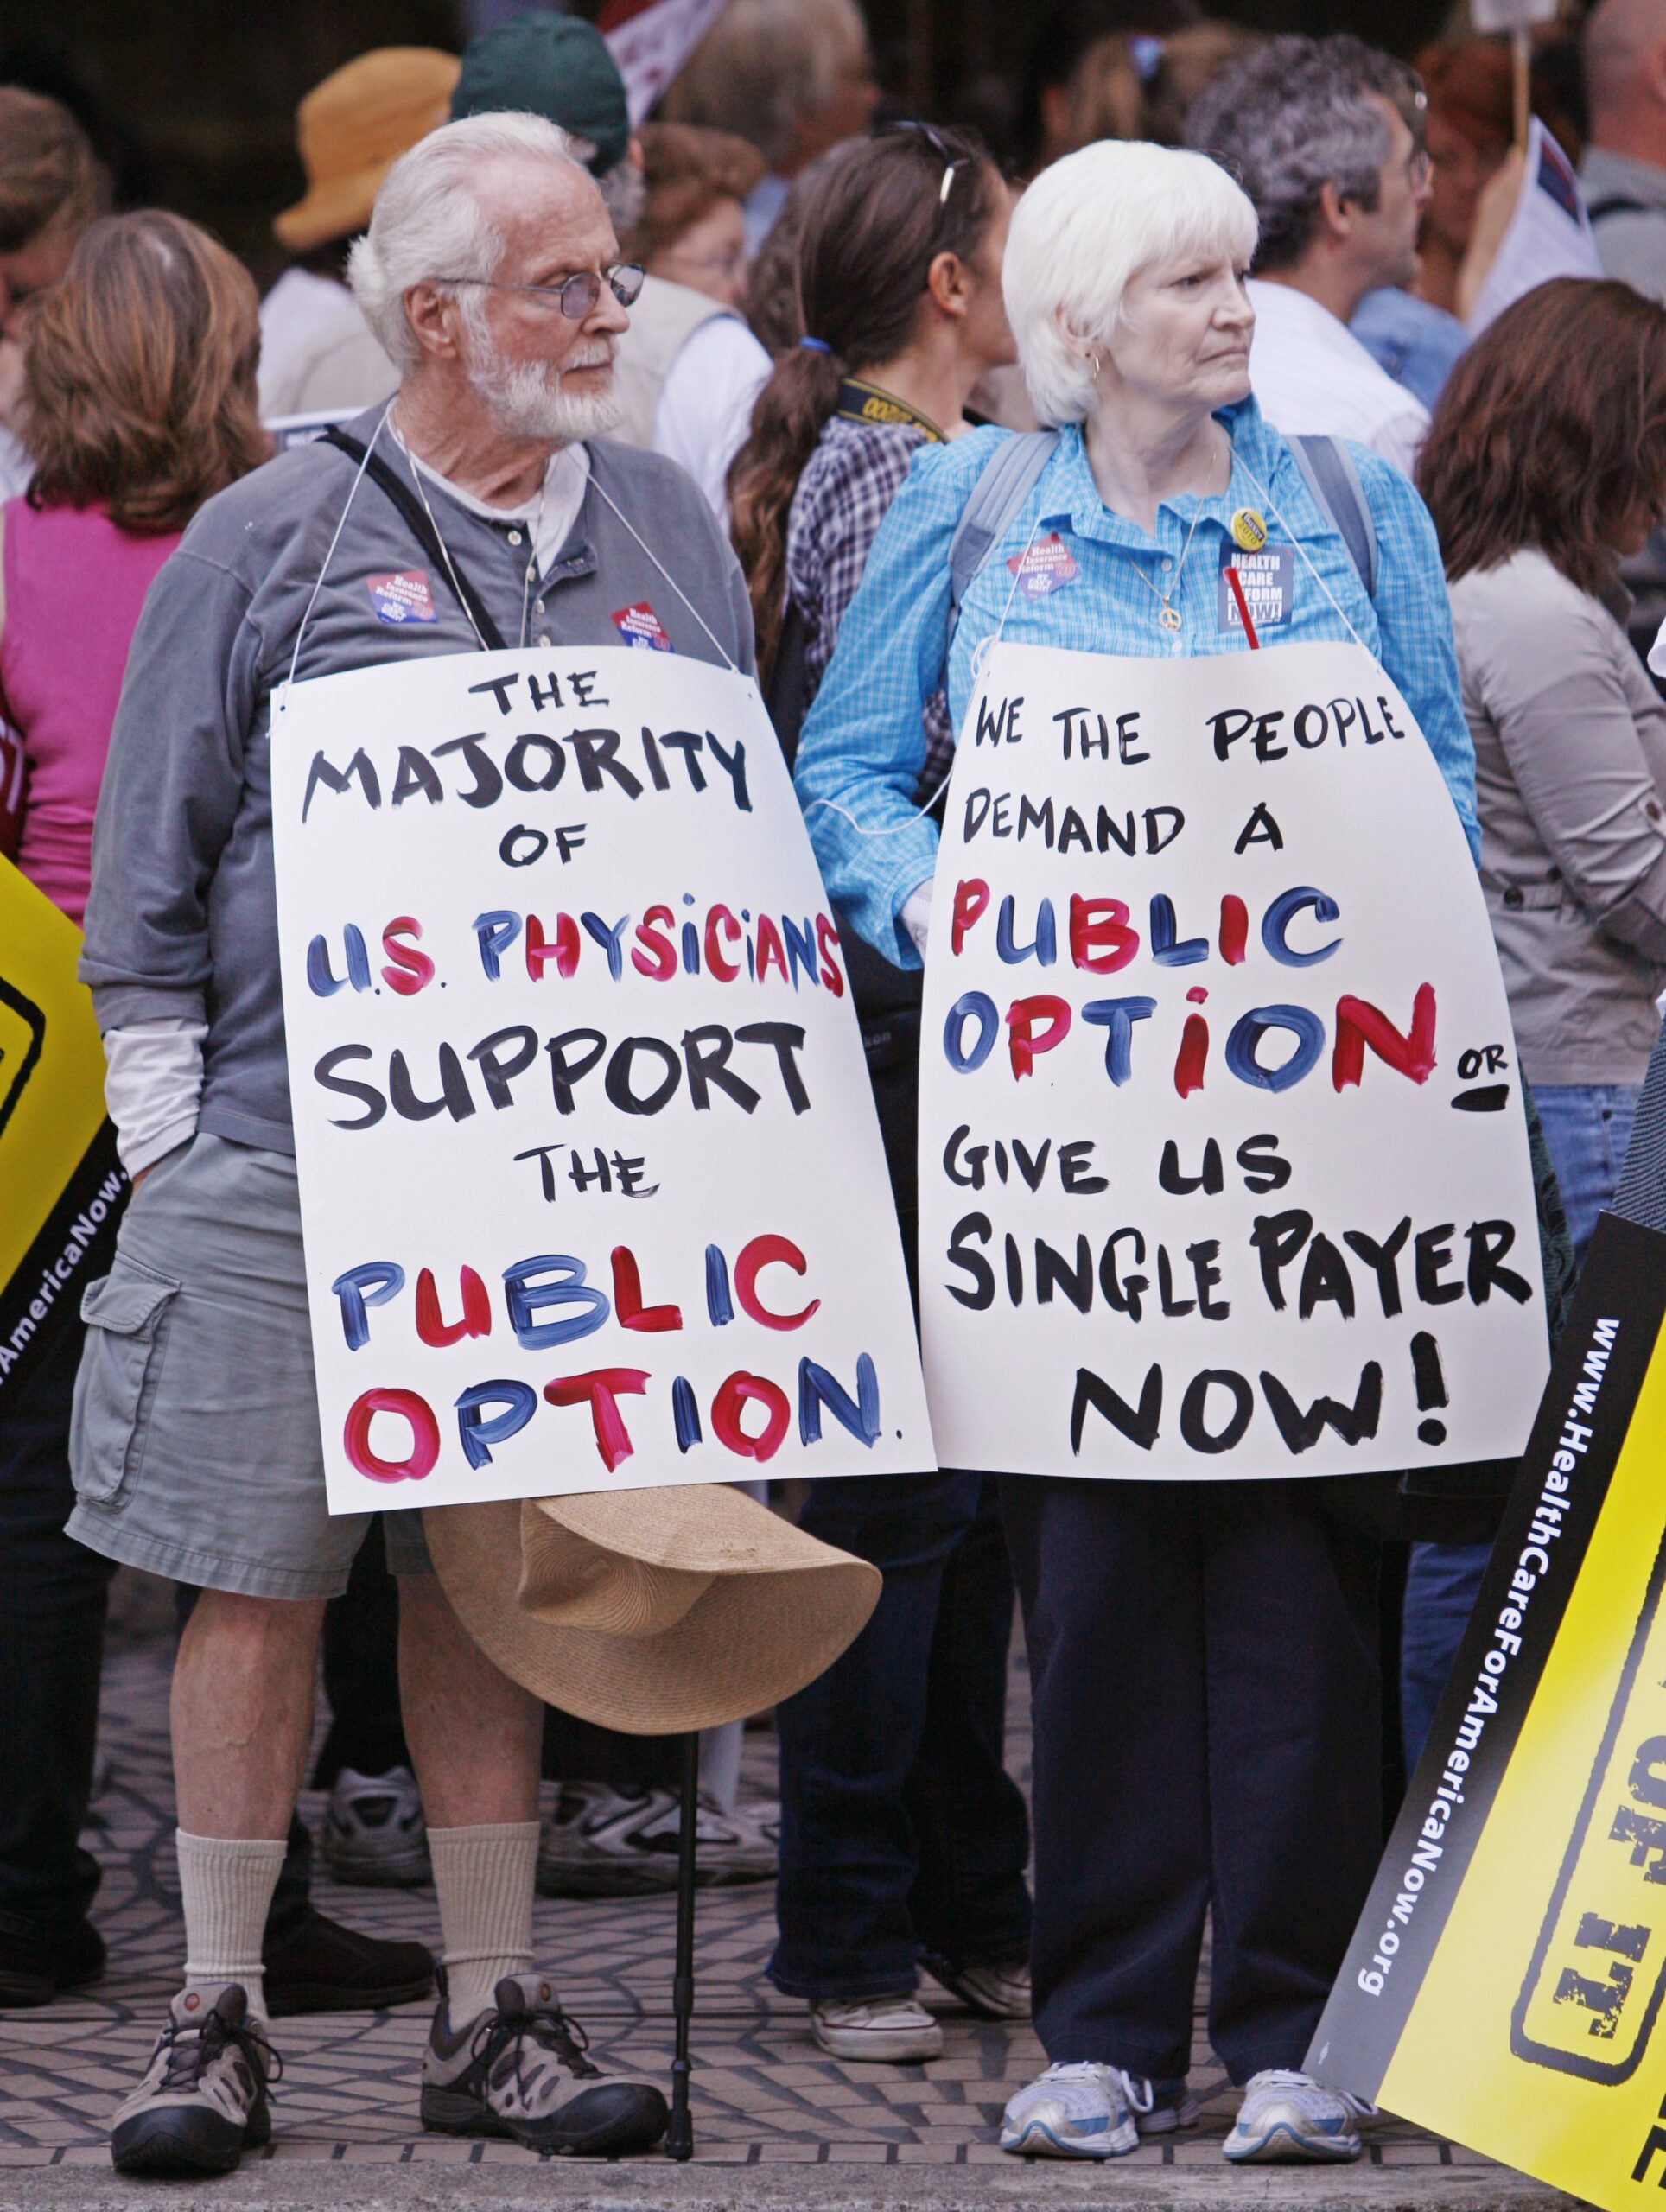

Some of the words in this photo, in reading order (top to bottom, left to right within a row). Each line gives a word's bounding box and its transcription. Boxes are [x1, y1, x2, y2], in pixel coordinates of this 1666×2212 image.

[1026, 553, 1068, 565] Insurance
[1032, 543, 1065, 556] Health
[1231, 553, 1281, 570] HEALTH
[1238, 522, 1257, 544] 2010
[375, 585, 413, 607] Reform
[385, 581, 429, 604] Insurance
[394, 575, 428, 595] Health
[1228, 588, 1282, 601] RFORM
[1239, 571, 1274, 586] CARE
[629, 607, 658, 625] Health
[468, 671, 609, 715] THE
[976, 696, 1025, 747] WE
[1052, 707, 1151, 765] THE
[1205, 696, 1406, 764] PEOPLE
[302, 727, 753, 823] MAJORITY
[499, 824, 587, 868] OF
[963, 787, 1186, 856] DEMAND
[1234, 802, 1284, 855] A
[307, 916, 447, 997] U.S.
[951, 878, 1345, 975] PUBLIC
[314, 1021, 811, 1130] SUPPORT
[1457, 1044, 1509, 1080] OR
[513, 1143, 661, 1202] THE
[943, 1124, 1110, 1195] GIVE
[1159, 1134, 1292, 1195] US
[0, 1171, 128, 1387] AmericaNow.
[332, 1234, 821, 1351] PUBLIC
[943, 1211, 1230, 1323] SINGLE
[1250, 1209, 1533, 1320] PAYER
[343, 1351, 904, 1484] OPTION.
[1071, 1331, 1450, 1457] NOW!
[1357, 1319, 1620, 1998] www.HealthCareForAmericaNow.org
[1553, 1912, 1651, 2039] IT
